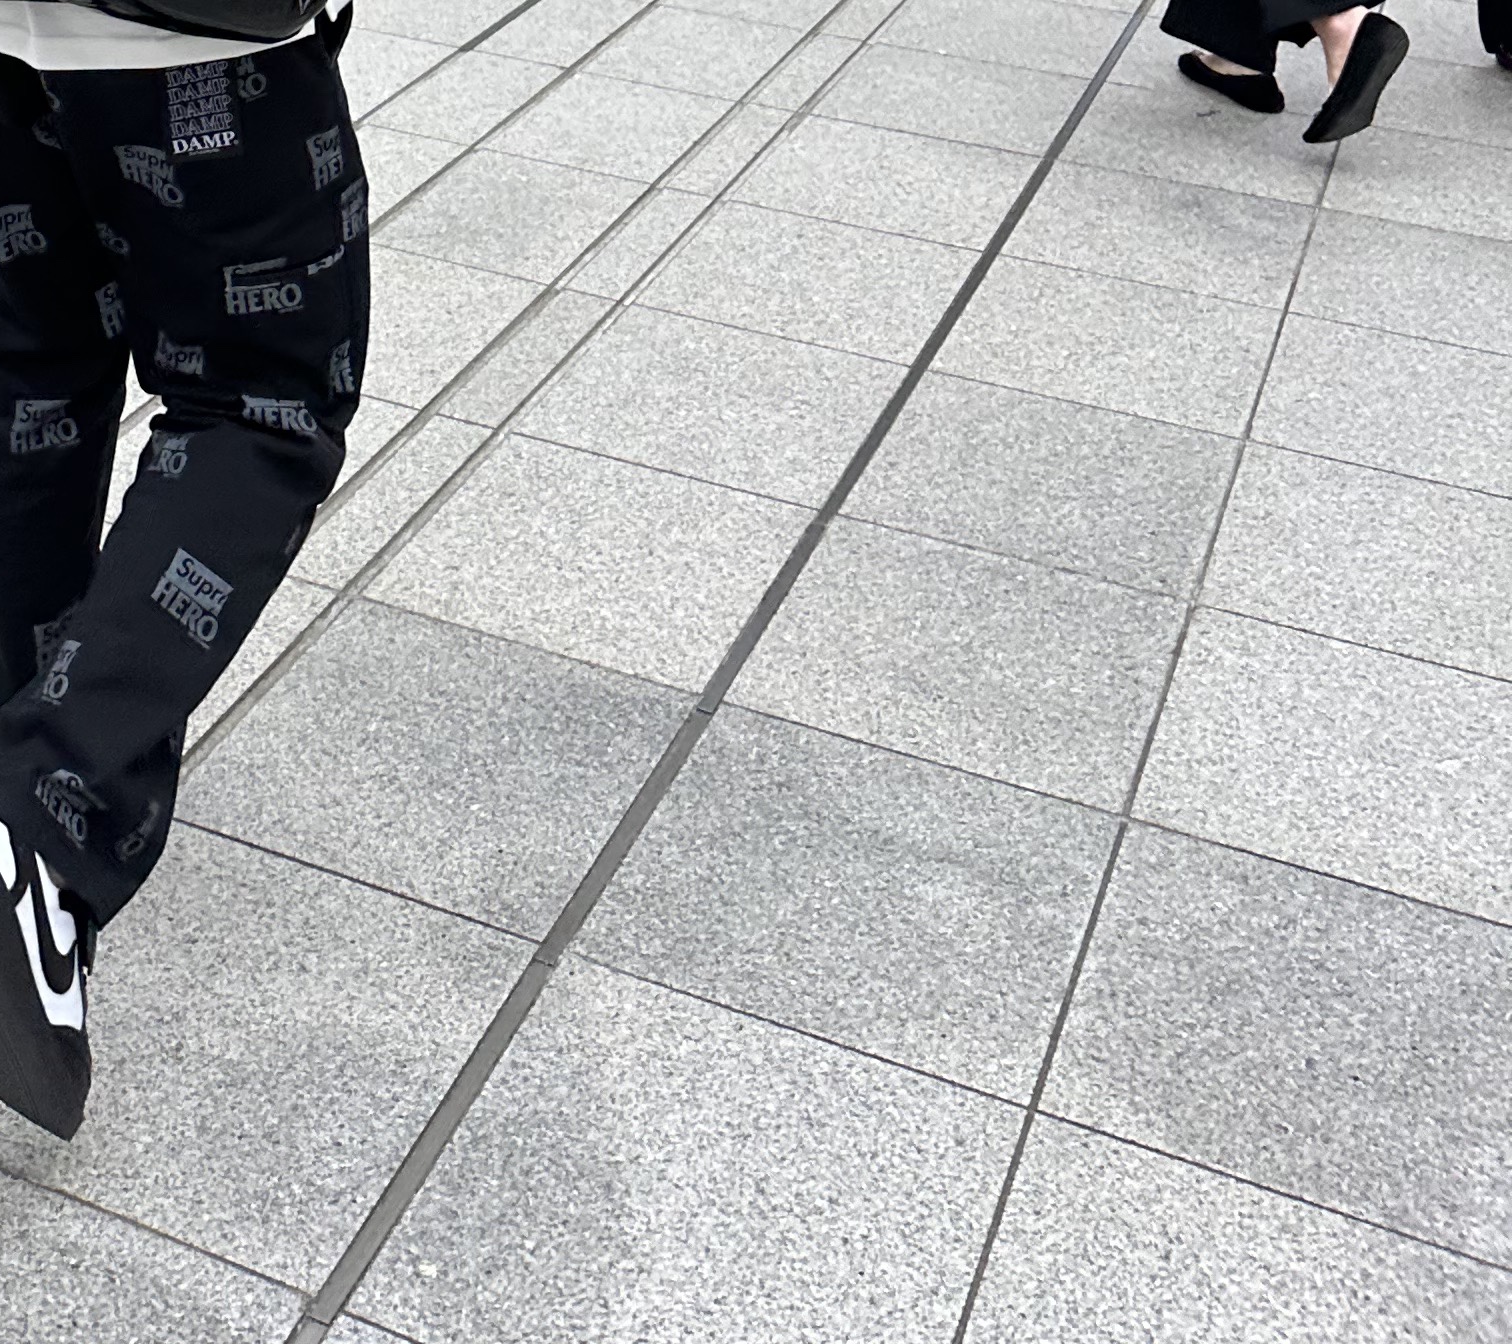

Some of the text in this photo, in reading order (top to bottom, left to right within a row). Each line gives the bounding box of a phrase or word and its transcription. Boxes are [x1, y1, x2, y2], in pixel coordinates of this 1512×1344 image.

[166, 61, 228, 88] DAMP
[168, 77, 230, 105] DAMP
[169, 94, 232, 122] DAMP
[171, 112, 234, 139] DAMP
[122, 161, 184, 206] HERO
[224, 282, 303, 315] HERO
[242, 408, 317, 435] HERO
[151, 576, 219, 642] HERO
